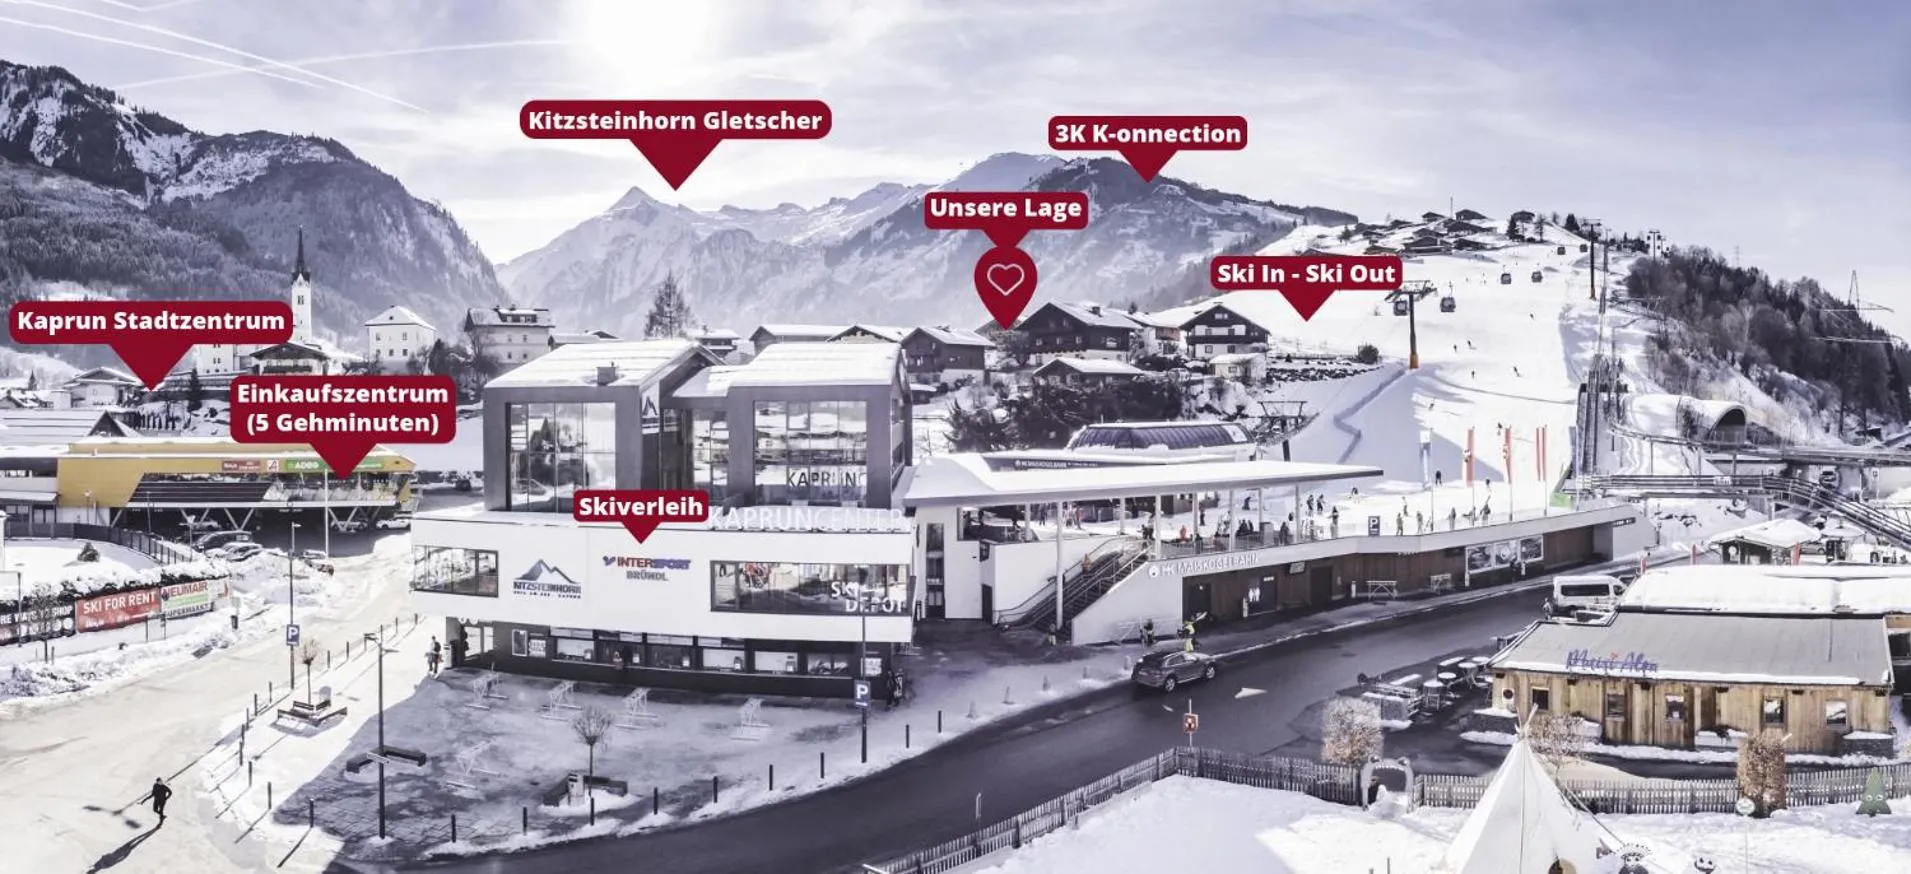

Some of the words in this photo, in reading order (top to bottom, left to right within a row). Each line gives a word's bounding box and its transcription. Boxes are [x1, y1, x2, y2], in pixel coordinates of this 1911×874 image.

[1370, 518, 1378, 529] P
[617, 556, 691, 569] INTERSPORT
[626, 569, 668, 581] BRÜNDL
[83, 601, 102, 614] SKI
[104, 597, 126, 611] FOR
[128, 591, 156, 606] RENT
[288, 627, 298, 639] P
[856, 684, 869, 699] P
